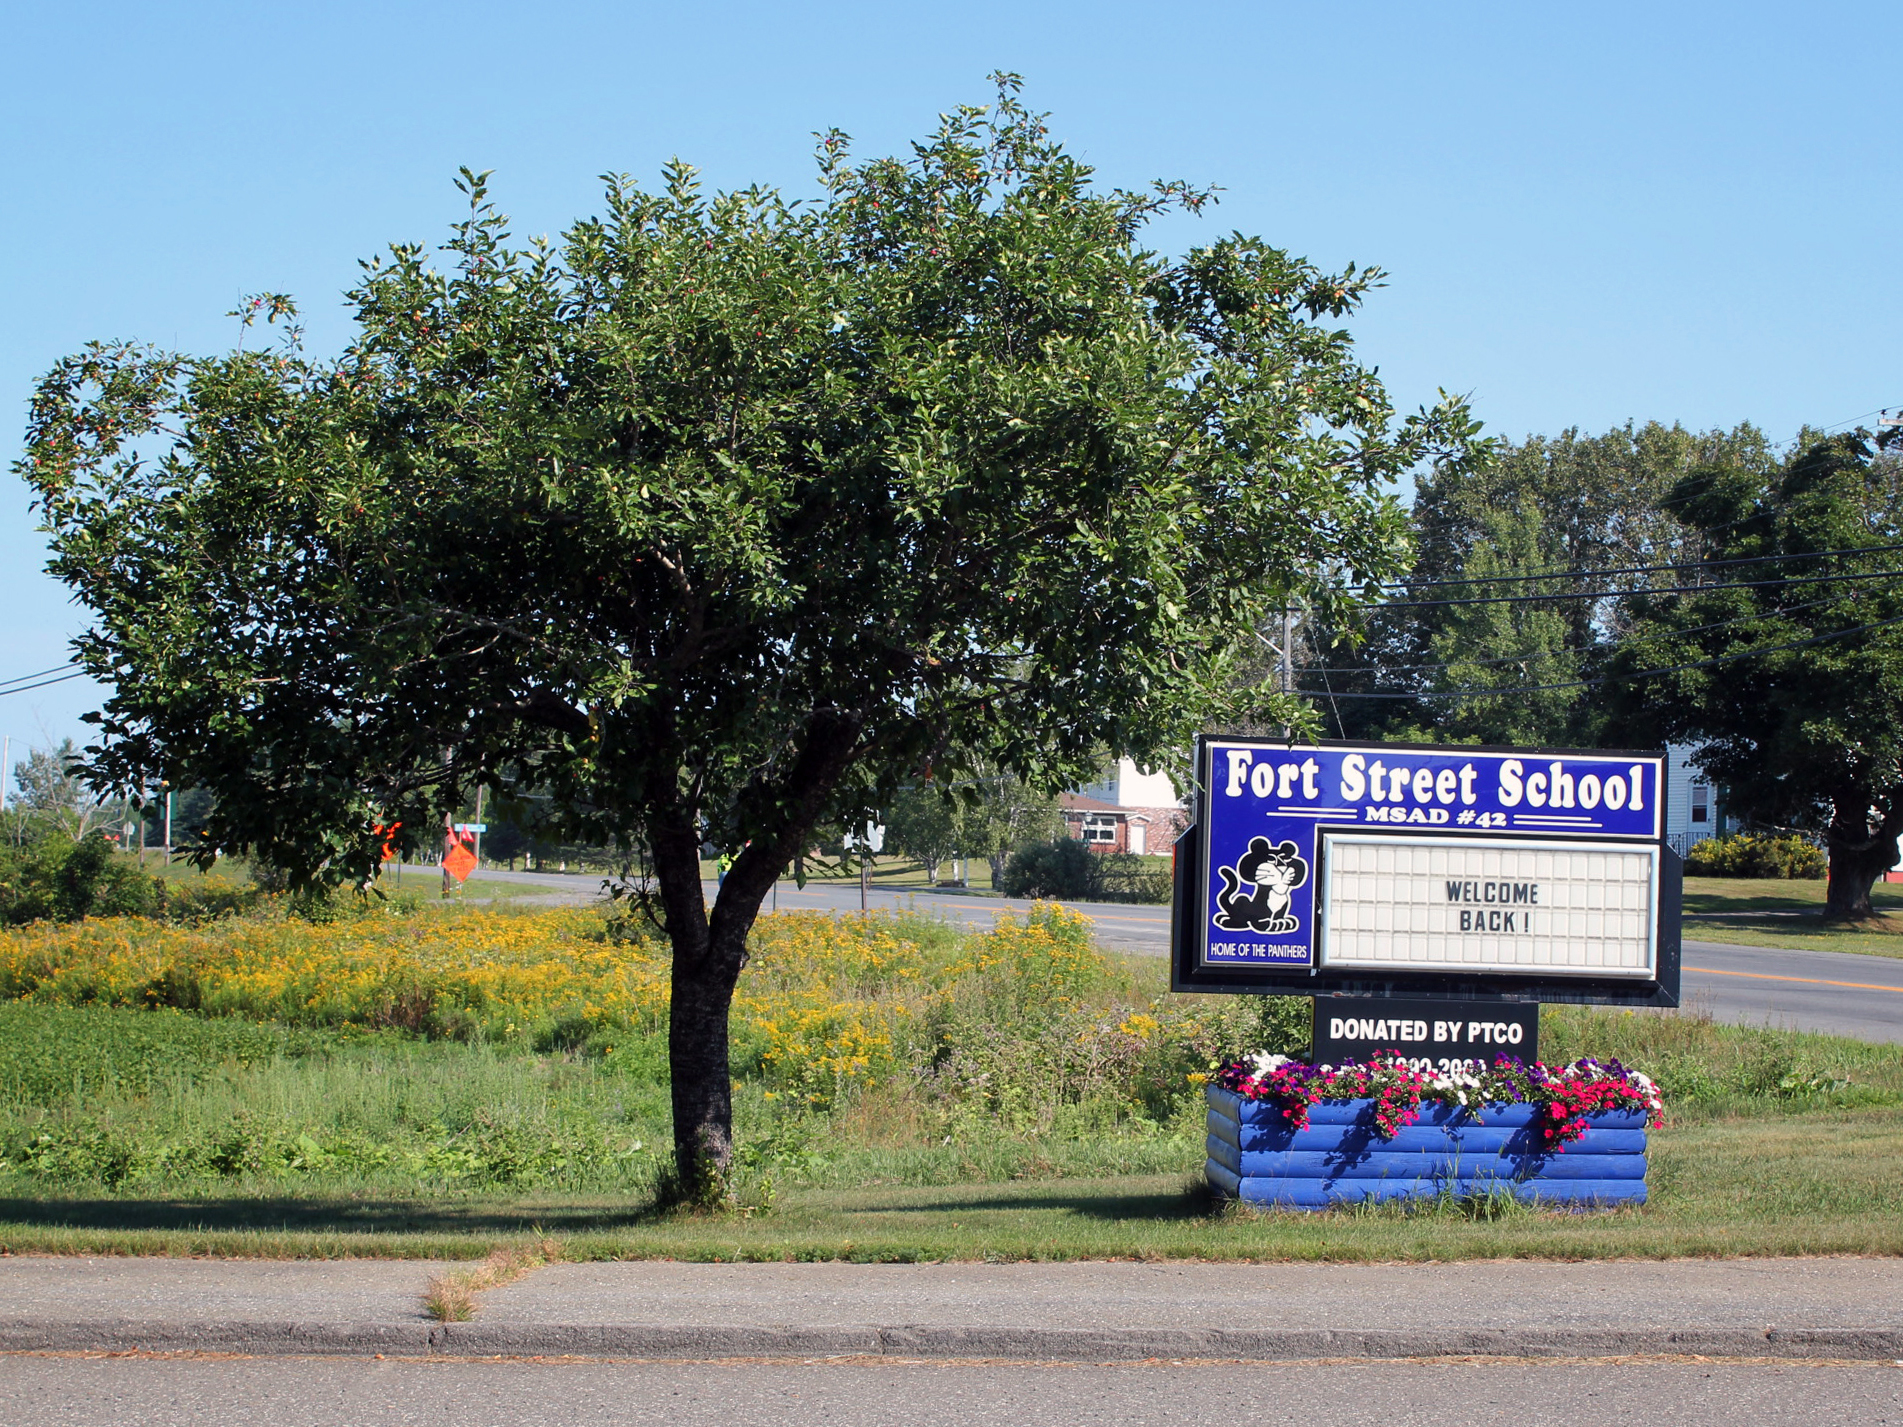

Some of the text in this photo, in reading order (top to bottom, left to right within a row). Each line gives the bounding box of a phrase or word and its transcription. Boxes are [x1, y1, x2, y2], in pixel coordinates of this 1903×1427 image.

[1225, 750, 1644, 811] Fort Street School
[1365, 806, 1507, 828] MSAD #42
[1446, 881, 1538, 904] WELCOME
[1211, 942, 1307, 958] HOME OF THE PANTHERS
[1330, 1018, 1523, 1044] DONATED BY PTCO
